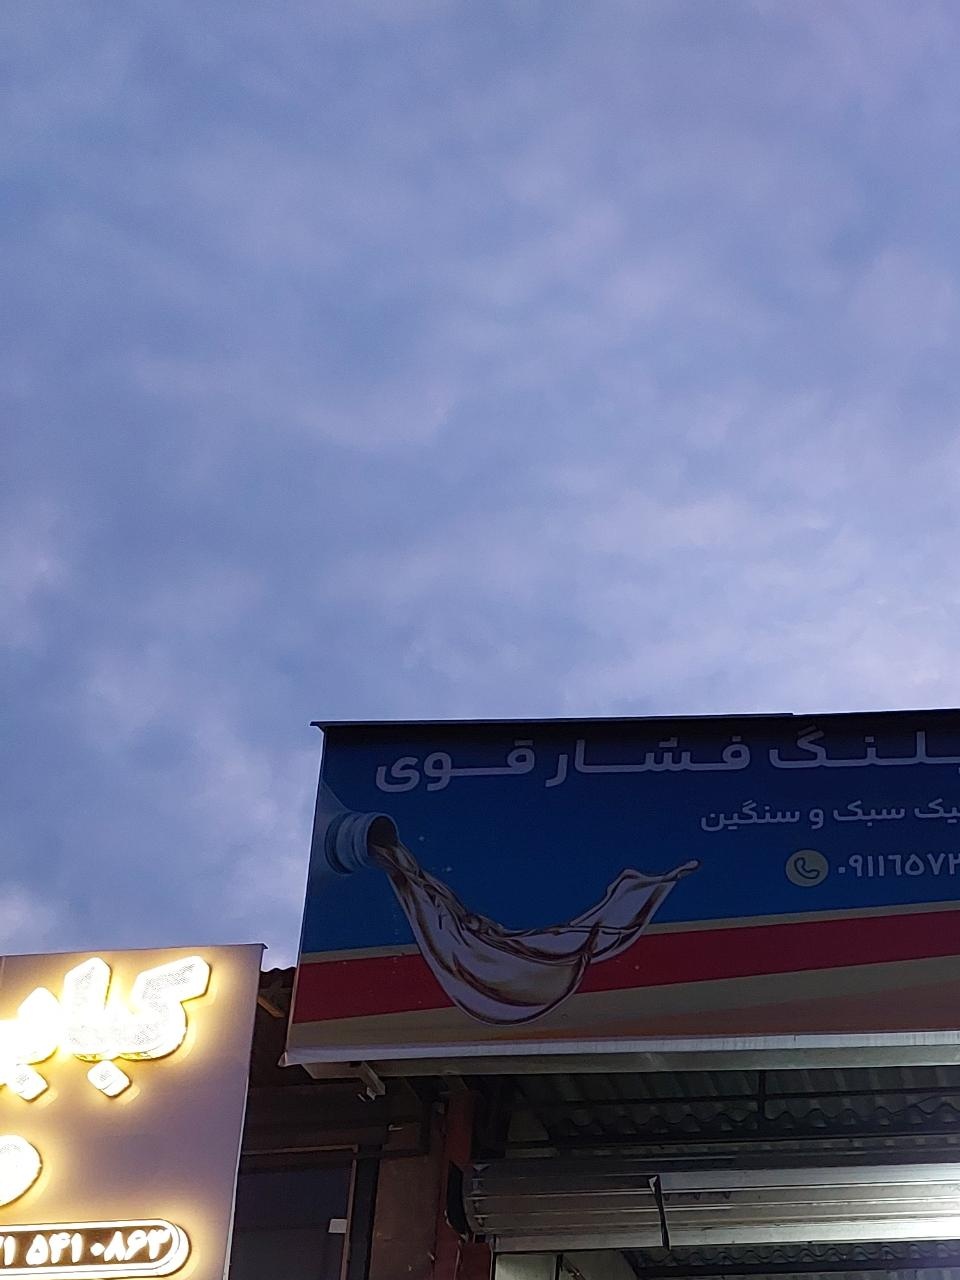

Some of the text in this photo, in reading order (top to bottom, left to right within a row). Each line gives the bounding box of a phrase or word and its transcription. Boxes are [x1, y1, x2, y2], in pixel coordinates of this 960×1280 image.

[375, 737, 536, 793] قوی
[544, 735, 751, 788] فشار
[700, 800, 801, 832] سنگین
[808, 805, 825, 830] و
[832, 800, 906, 827] سبک
